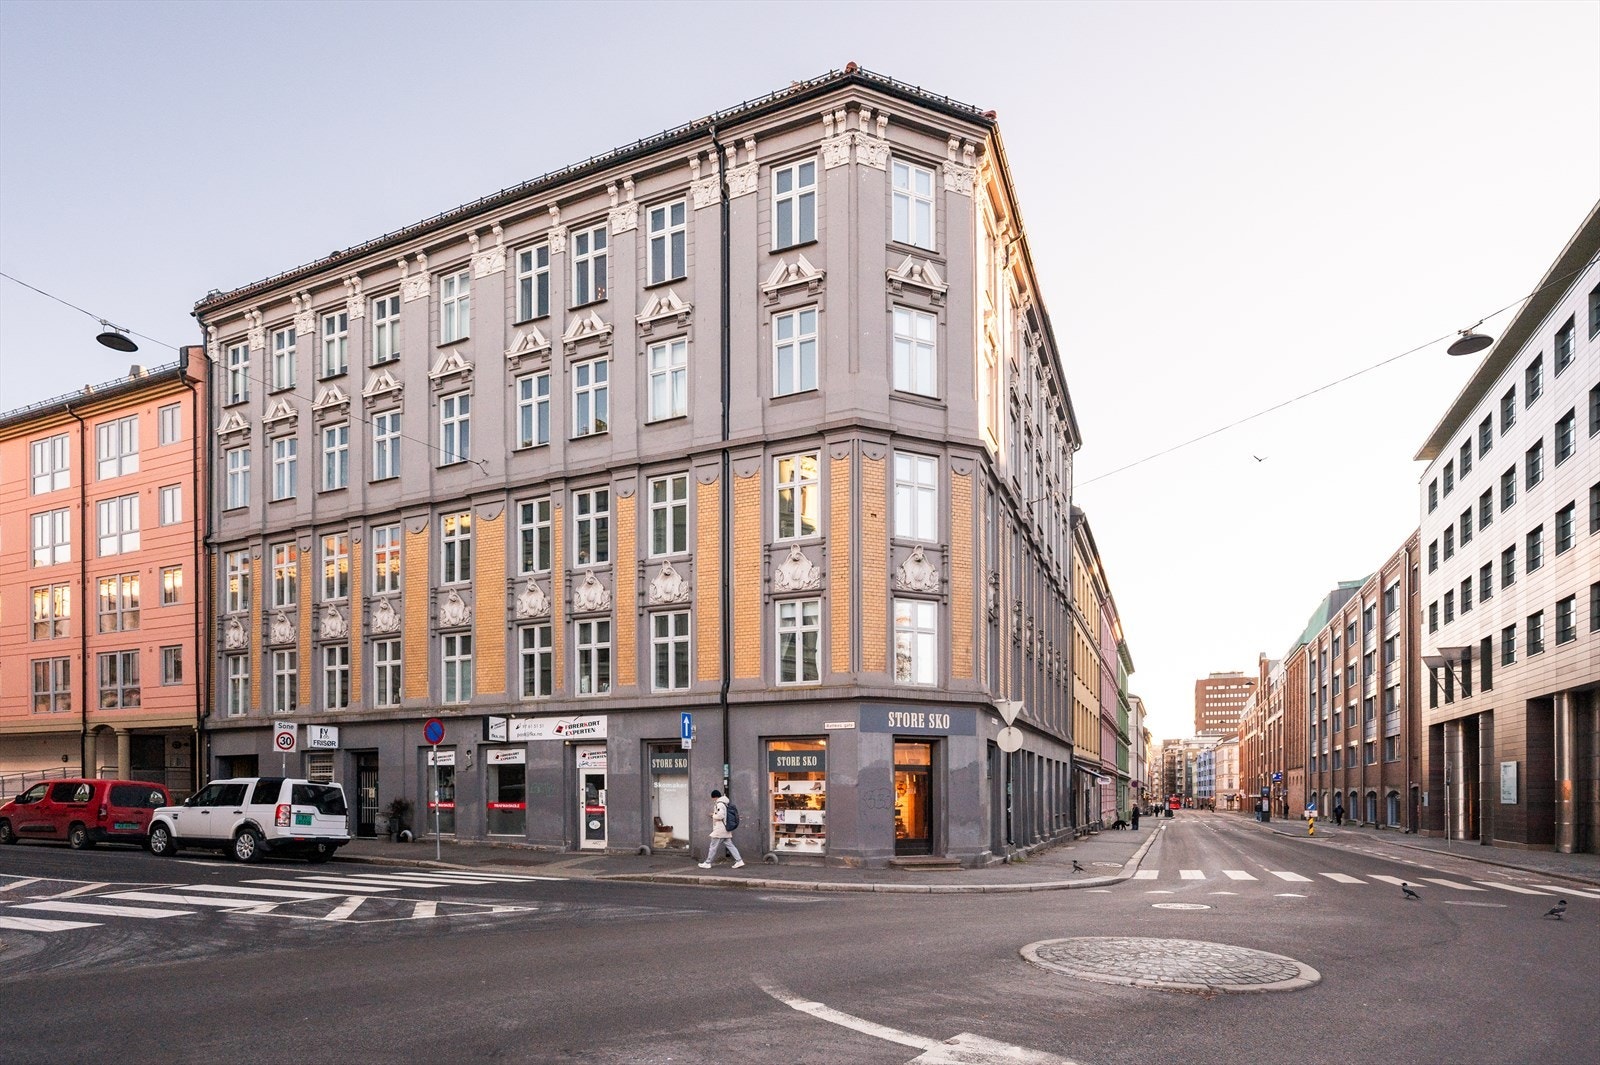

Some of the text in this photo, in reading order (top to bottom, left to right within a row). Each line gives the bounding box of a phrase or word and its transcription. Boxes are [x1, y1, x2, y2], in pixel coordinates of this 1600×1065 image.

[564, 720, 600, 730] FØRERKORT
[888, 711, 950, 729] STORE SKO
[278, 722, 294, 730] Sone
[565, 727, 596, 736] EXPERTEN
[280, 736, 292, 746] 30
[652, 758, 688, 768] STORE SKO
[776, 756, 818, 767] STORE SKO
